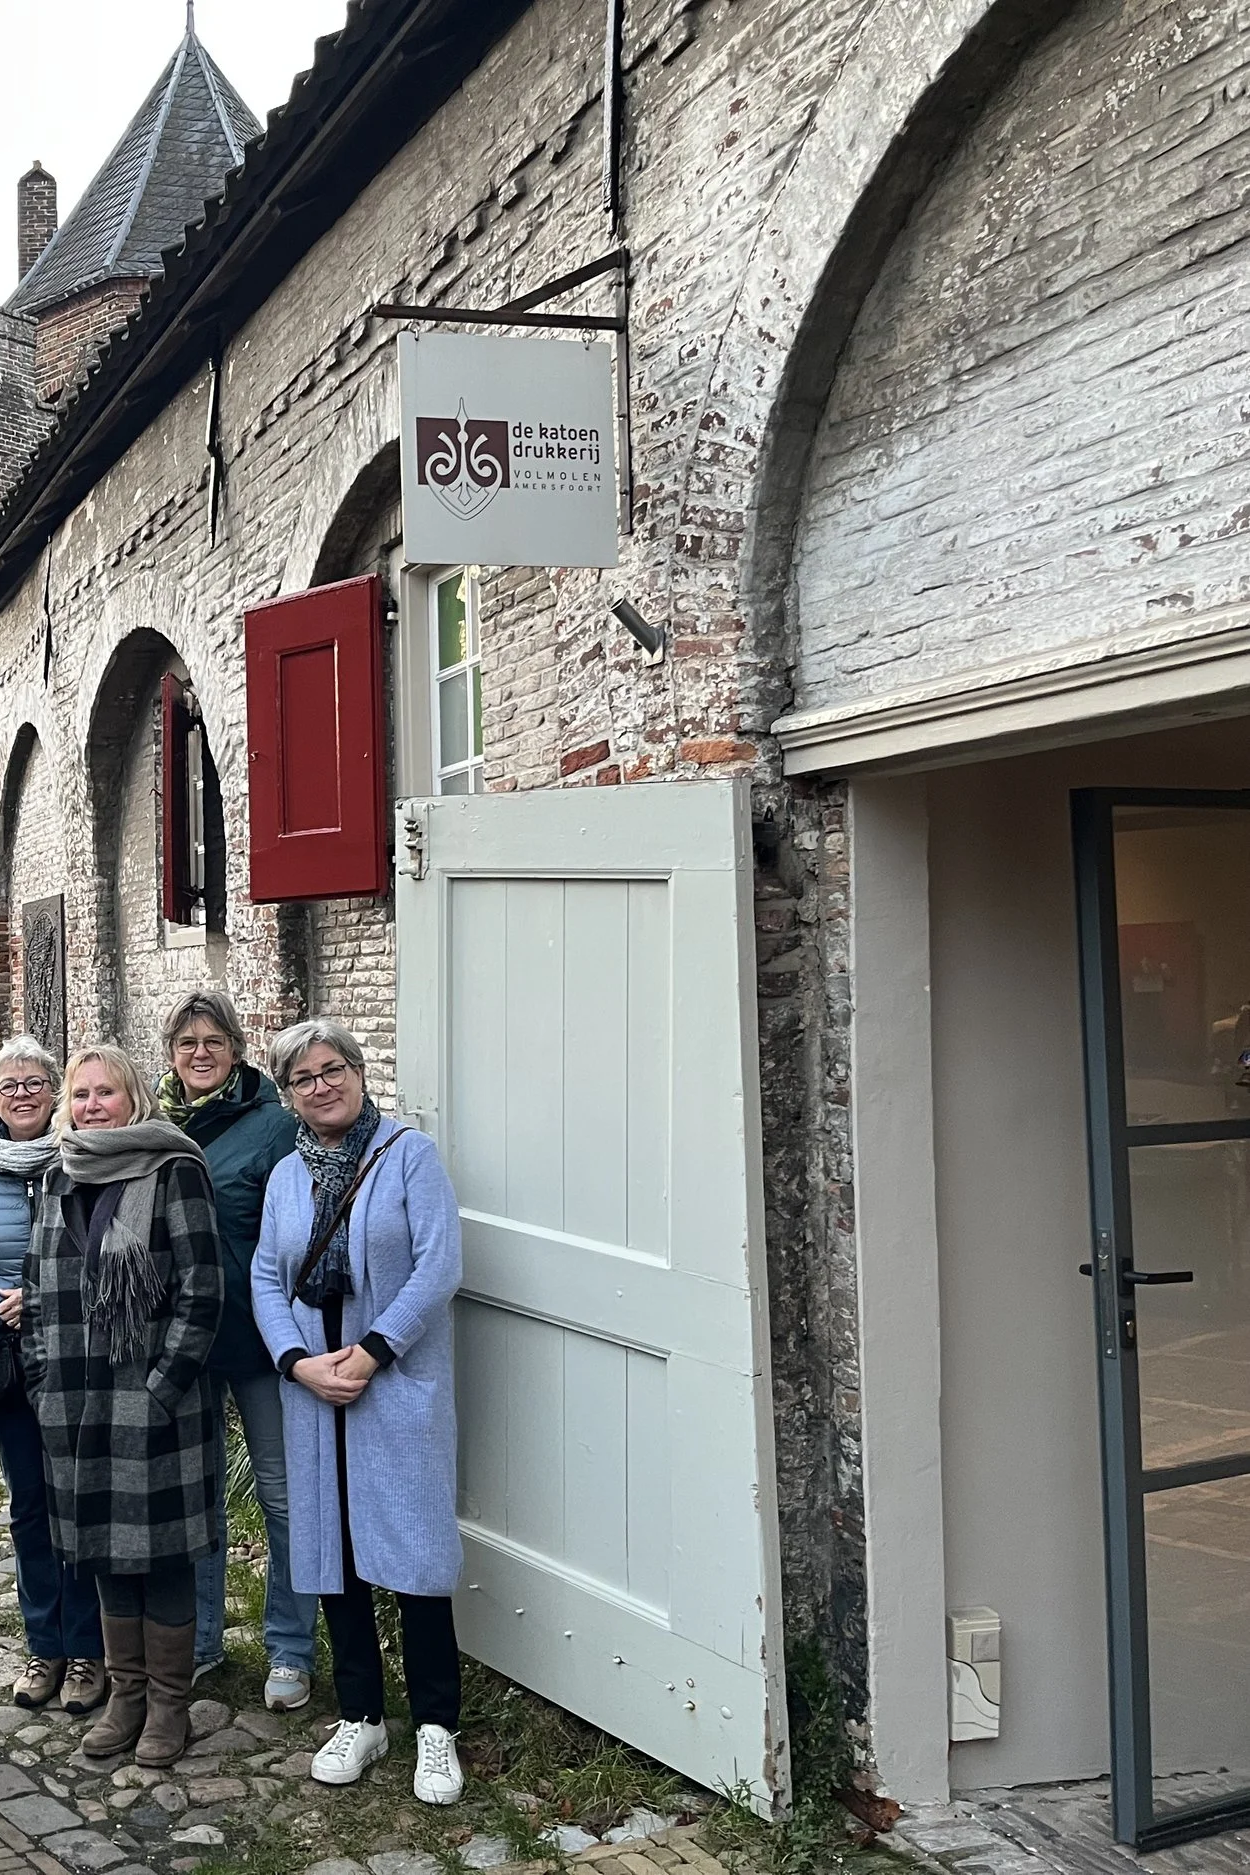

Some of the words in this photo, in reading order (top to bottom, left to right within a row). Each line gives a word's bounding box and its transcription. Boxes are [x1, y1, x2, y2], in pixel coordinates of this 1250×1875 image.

[512, 421, 533, 439] de
[539, 422, 599, 442] katoen
[513, 440, 600, 465] drukkerij
[513, 469, 601, 482] VOLMOLEN
[514, 482, 601, 493] AMERSFOORT
